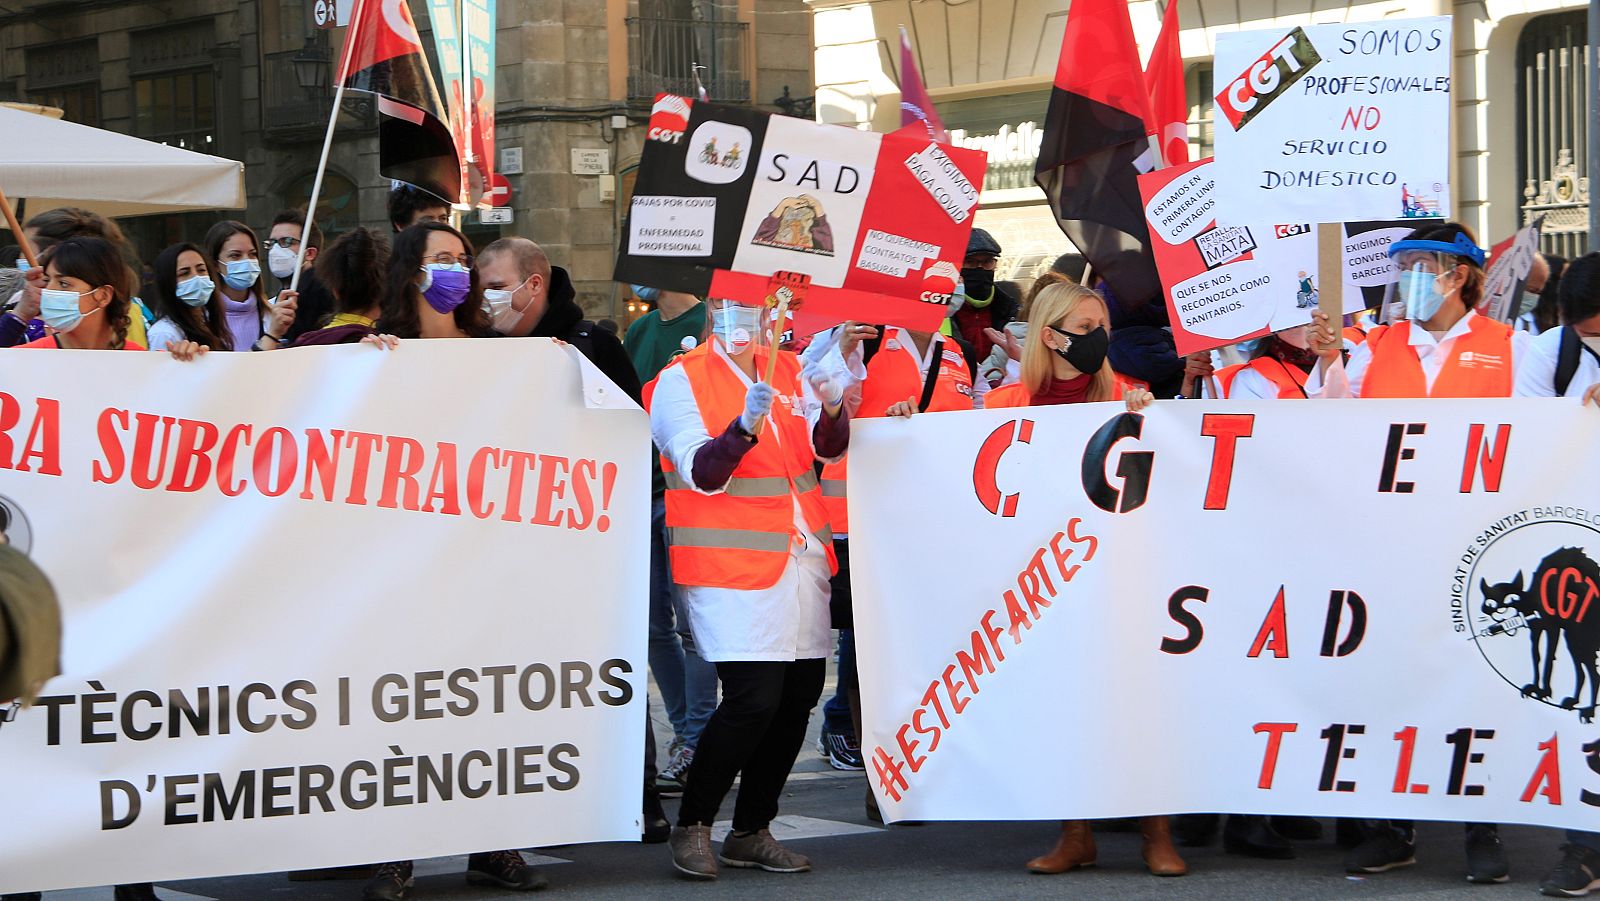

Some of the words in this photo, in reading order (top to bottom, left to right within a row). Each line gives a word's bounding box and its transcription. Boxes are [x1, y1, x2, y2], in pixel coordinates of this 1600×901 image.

[1338, 28, 1443, 56] SOMOS
[1228, 34, 1303, 112] CGT
[1304, 75, 1450, 96] PROFESIONALES
[1341, 105, 1381, 131] NO
[649, 126, 685, 144] CGT
[1282, 139, 1388, 156] SERVICIO
[767, 153, 859, 194] SAD
[929, 146, 978, 201] EXIGIMOS
[1259, 169, 1398, 190] DOMESTICO
[907, 156, 936, 191] PAGA
[934, 187, 966, 222] COVID
[1153, 183, 1190, 217] ESTAMOS
[1189, 173, 1202, 187] EN
[632, 198, 662, 207] BAJAS
[663, 198, 684, 208] POR
[685, 199, 716, 208] COVID
[1161, 196, 1198, 227] PRIMERA
[1171, 198, 1216, 237] CONTAGIOS
[1277, 223, 1308, 238] CGT
[639, 227, 704, 238] ENFERMEDAD
[869, 230, 884, 241] NO
[884, 233, 935, 254] QUEREMOS
[1202, 240, 1215, 250] LA
[1213, 227, 1244, 246] SANITAT
[1345, 236, 1392, 253] EXIGIMOS
[638, 241, 703, 252] PROFESIONAL
[863, 245, 918, 265] CONTRATOS
[1206, 234, 1251, 263] MATA
[1348, 251, 1389, 266] CONVEN
[859, 259, 901, 276] BASURAS
[919, 290, 952, 305] CGT
[1176, 284, 1197, 299] QUE
[1199, 280, 1210, 292] SE
[1211, 272, 1232, 287] NOS
[1181, 287, 1239, 313] RECONOZCA
[1239, 275, 1271, 292] COMO
[1185, 299, 1245, 326] SANITARIOS.
[0, 391, 63, 477] RA
[92, 407, 618, 532] SUBCONTRACTES!
[972, 411, 1256, 518] CGT
[1377, 422, 1512, 493] EN
[1450, 565, 1468, 633] SINDICAT
[1461, 544, 1480, 565] DE
[1476, 510, 1529, 547] SANITAT
[1533, 506, 1600, 526] BARCELO
[1540, 567, 1600, 623] CGT
[1159, 584, 1368, 659] SAD
[871, 516, 1099, 803] #ESTEMFARTES
[33, 679, 317, 746] TÈCNICS
[338, 677, 352, 727] I
[371, 658, 633, 723] GESTORS
